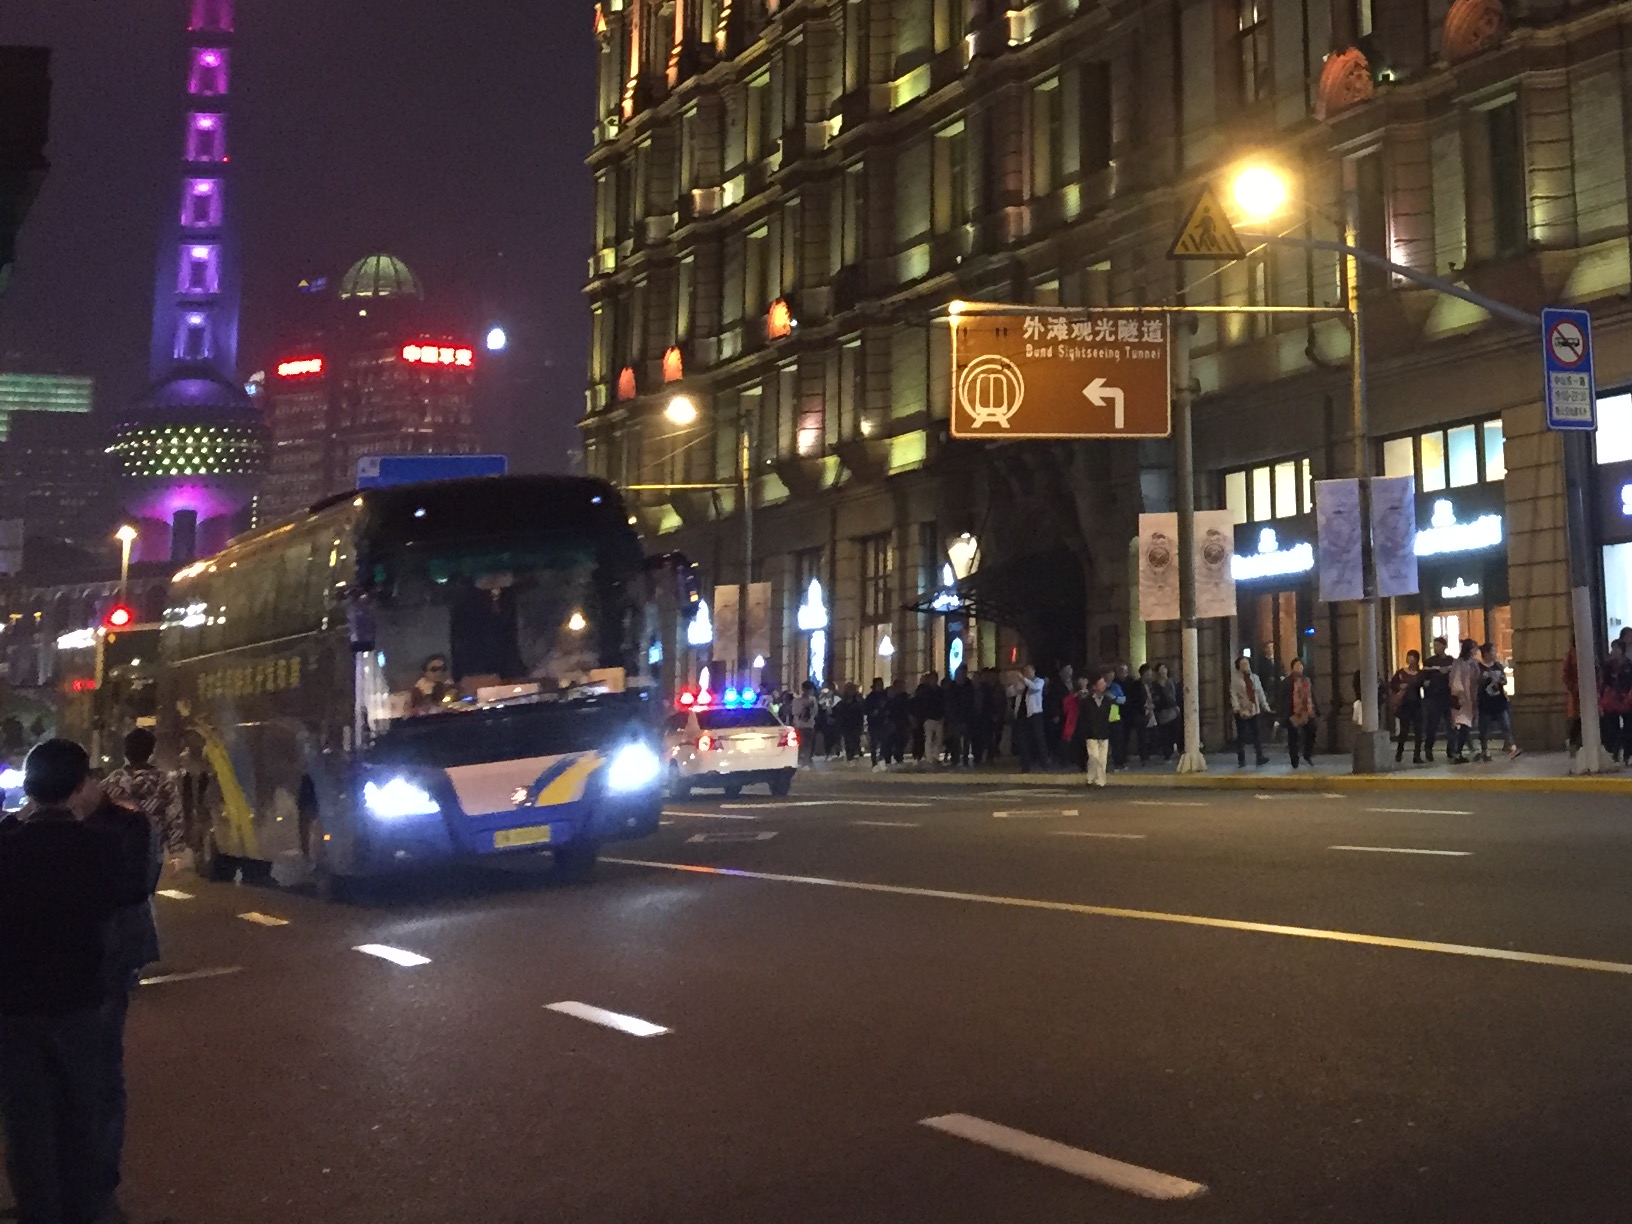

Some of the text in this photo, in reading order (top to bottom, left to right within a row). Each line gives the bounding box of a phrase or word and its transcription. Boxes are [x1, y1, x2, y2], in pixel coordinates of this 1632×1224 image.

[1022, 316, 1164, 343] 外滩观光隧道
[1025, 343, 1053, 358] Bund
[1058, 344, 1120, 362] Sightseeing
